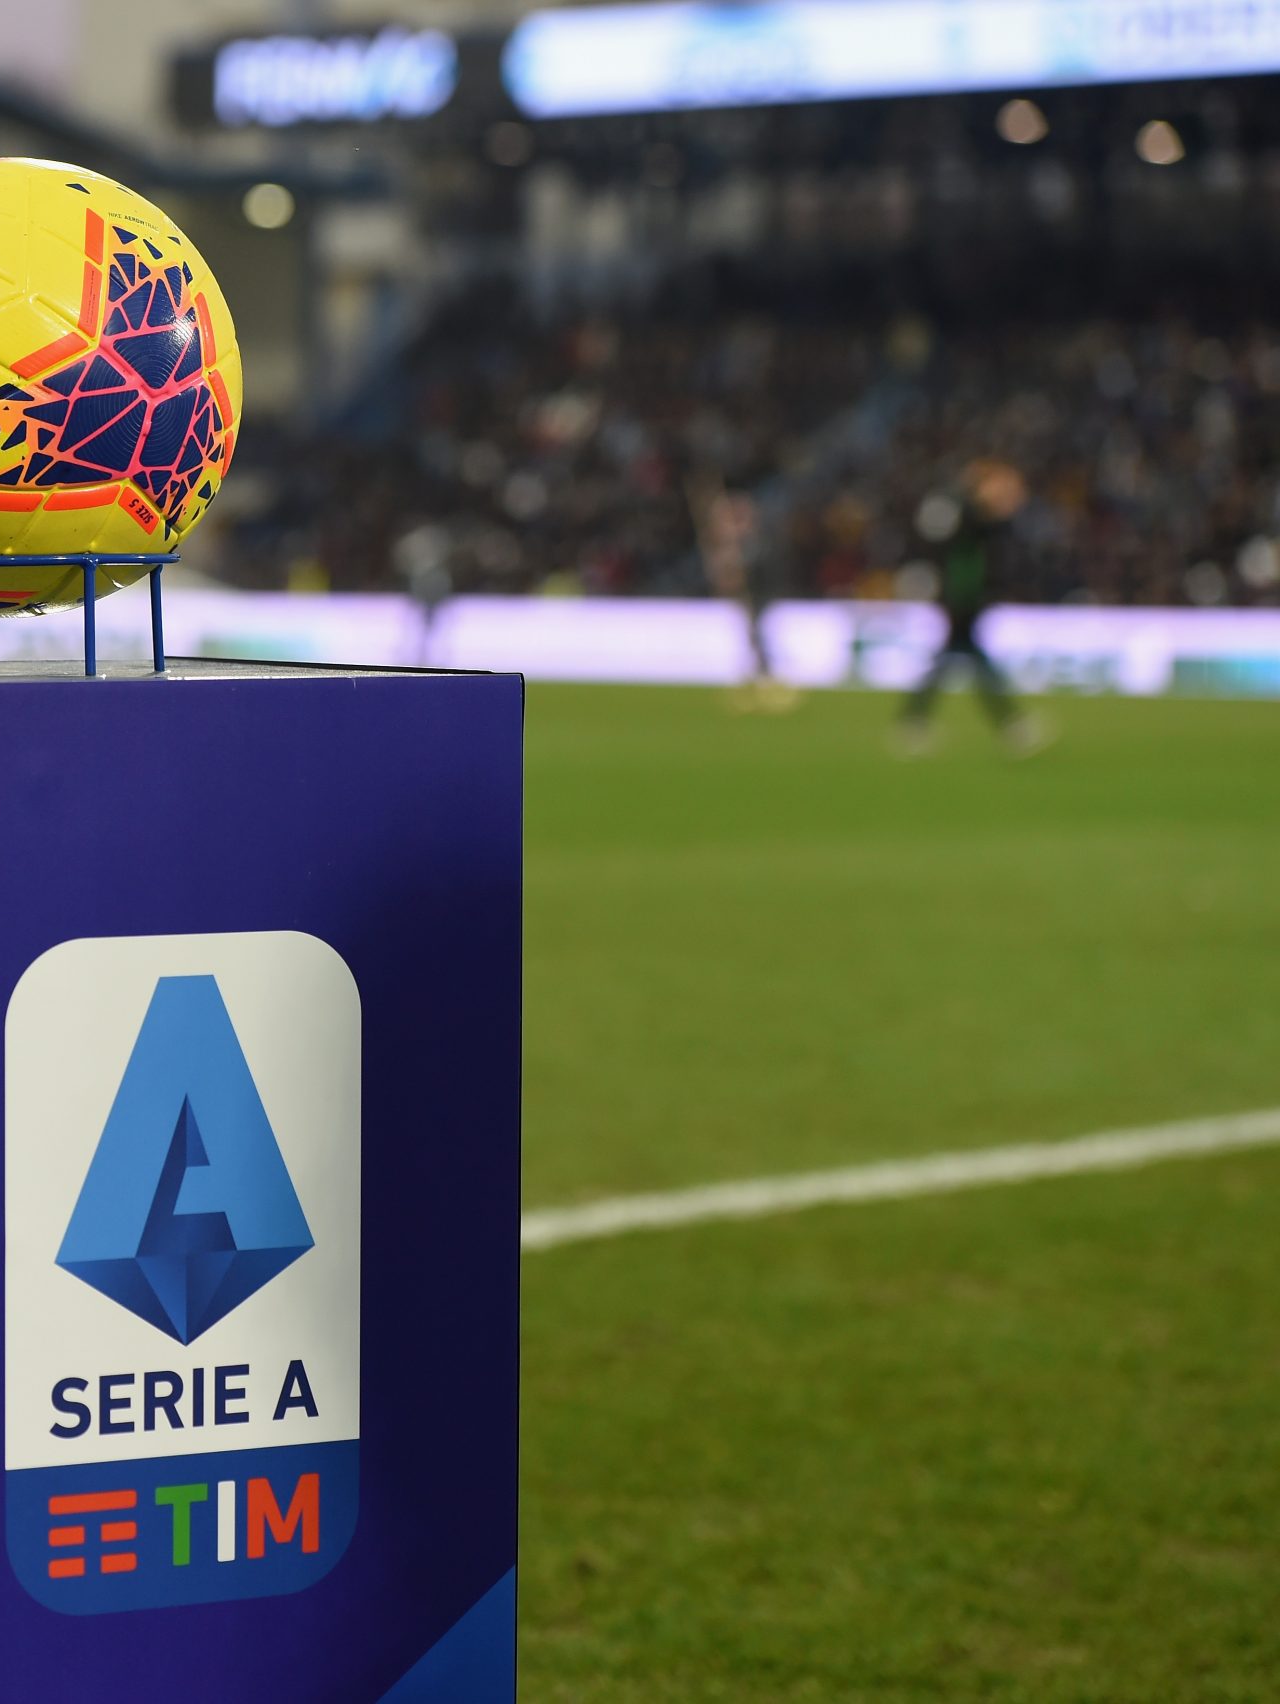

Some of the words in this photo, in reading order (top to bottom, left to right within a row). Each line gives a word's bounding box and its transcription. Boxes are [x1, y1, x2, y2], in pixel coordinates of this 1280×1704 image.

[128, 498, 140, 508] 5
[135, 504, 154, 524] SIZE
[49, 1363, 250, 1439] SERIE
[272, 1359, 320, 1421] A
[155, 1473, 320, 1566] TIM
